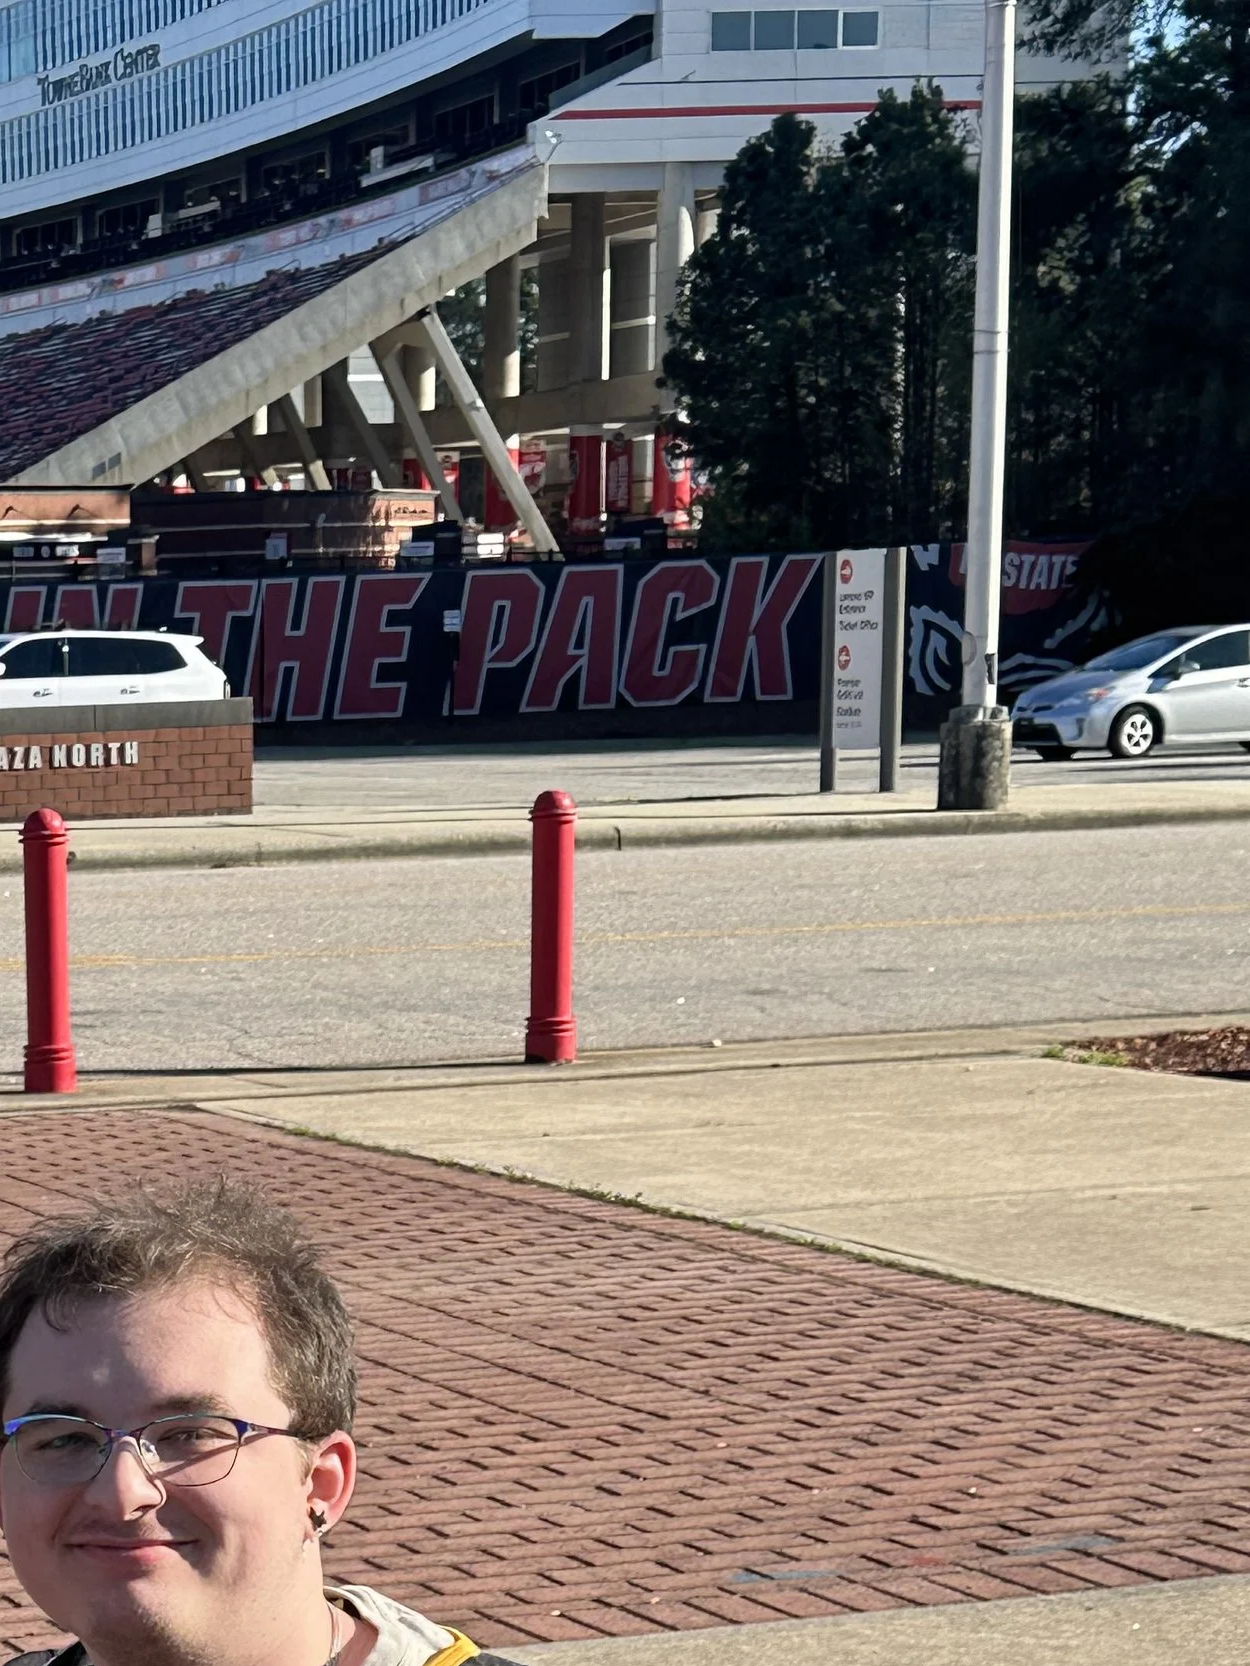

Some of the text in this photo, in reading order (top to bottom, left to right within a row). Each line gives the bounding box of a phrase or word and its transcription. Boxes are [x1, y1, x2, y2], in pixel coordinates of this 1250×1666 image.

[171, 572, 432, 722] THE
[446, 552, 827, 717] PACK
[53, 741, 139, 768] NORTH
